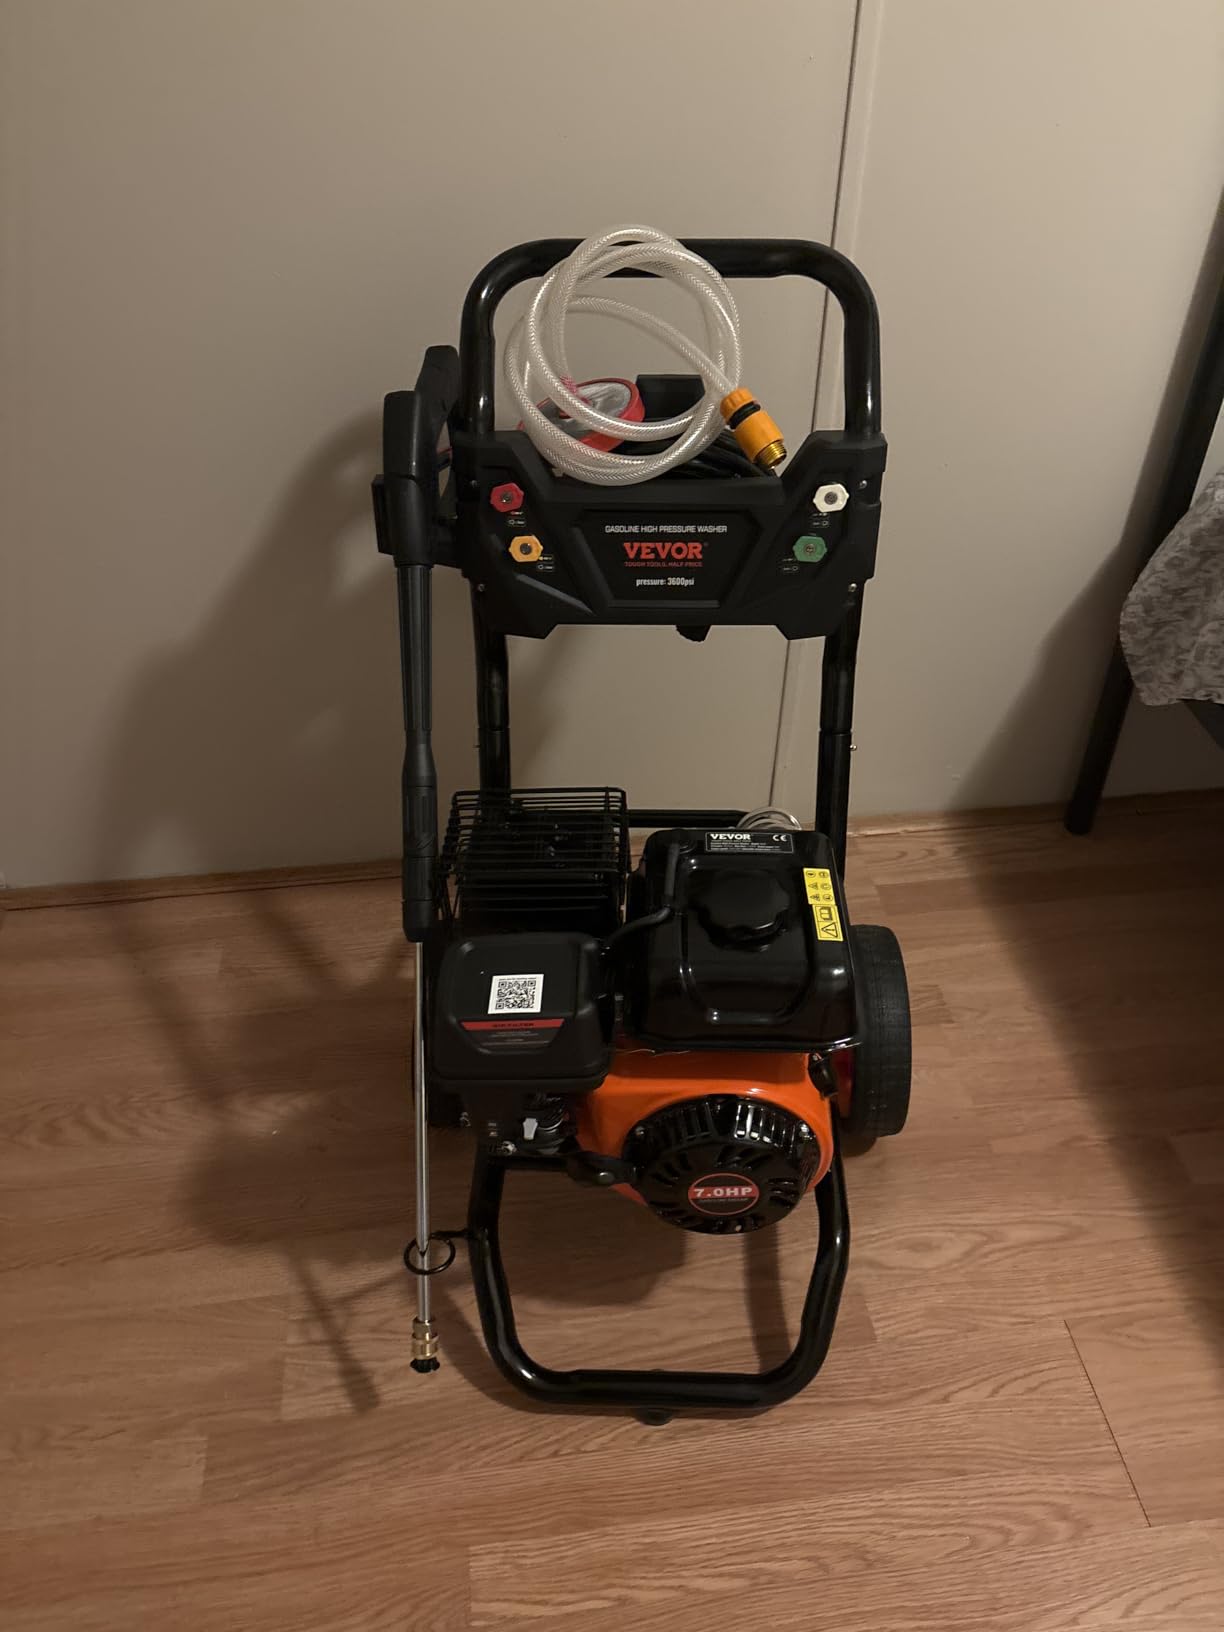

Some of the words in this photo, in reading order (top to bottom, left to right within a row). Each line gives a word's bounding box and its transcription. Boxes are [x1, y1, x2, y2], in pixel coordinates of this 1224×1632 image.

[605, 525, 639, 533] GASOLINE
[641, 525, 657, 533] HIGH
[659, 525, 696, 533] PRESSURE
[697, 525, 727, 533] WASHER
[623, 542, 703, 559] VEVOR
[636, 578, 666, 587] pressure:
[667, 577, 695, 587] 3600psi
[693, 1187, 753, 1197] 7.0HP
